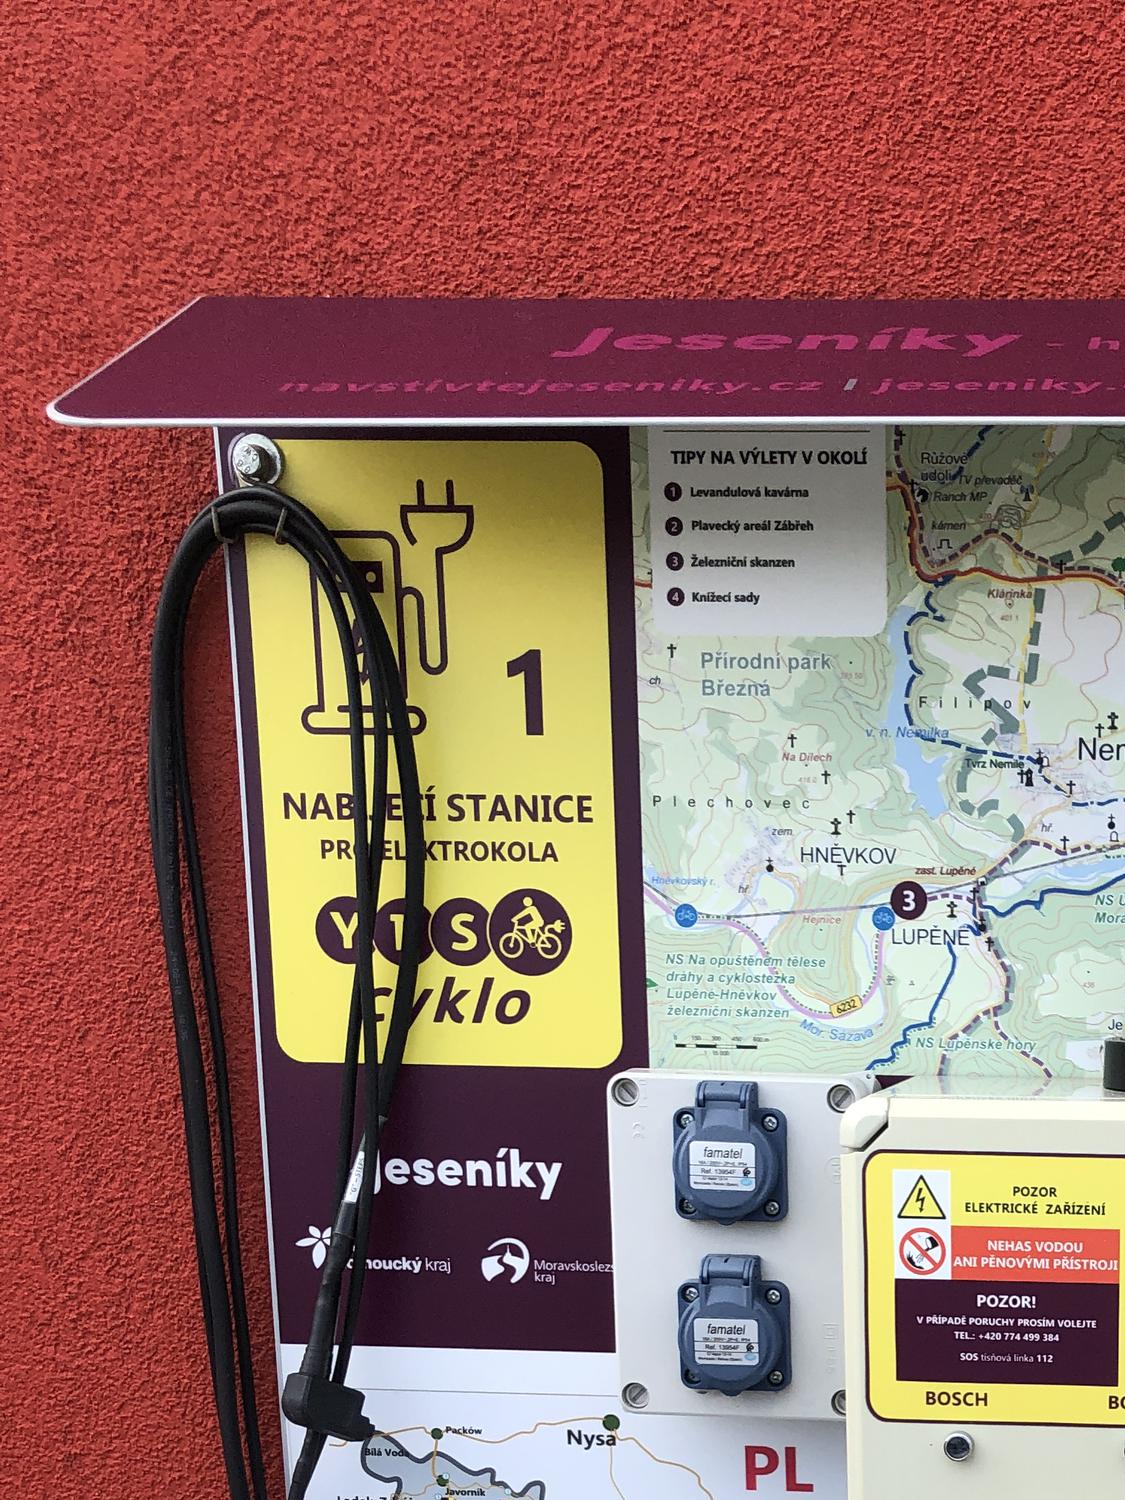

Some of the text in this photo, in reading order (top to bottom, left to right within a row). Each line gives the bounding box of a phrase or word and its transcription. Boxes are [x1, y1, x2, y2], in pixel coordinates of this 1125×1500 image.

[550, 327, 1023, 357] Jeseníky
[670, 447, 868, 465] TIPY NA VÝLETY V OKOLÍ
[690, 487, 761, 498] Levandulová
[765, 487, 809, 498] kavárna
[691, 521, 740, 533] Plavecký
[744, 521, 770, 531] areál
[774, 521, 813, 531] Zábřeh
[691, 555, 747, 567] Železniční
[750, 558, 795, 567] skanzen
[691, 592, 731, 602] Knížecí
[735, 593, 760, 605] sady
[701, 652, 831, 673] Přírodní park
[507, 649, 545, 736] 1
[701, 679, 771, 697] Březná
[447, 794, 593, 823] STANICE
[383, 840, 559, 862] ELKTROKOLA
[800, 843, 896, 864] HNĚVKOV
[902, 890, 915, 911] 3
[836, 998, 857, 1014] 6232
[703, 1146, 743, 1160] famatel
[1013, 1186, 1057, 1197] POZOR
[965, 1201, 1106, 1215] ELEKTRICKÉ ZAŘÍZENÍ
[987, 1240, 1083, 1253] NEHAS VODOU
[425, 1257, 451, 1274] kraj
[953, 1255, 1118, 1271] ANI PĚNOVÝMI PŘÍSTROJI
[534, 1271, 555, 1285] kraj
[976, 1295, 1036, 1308] POZOR!
[916, 1315, 1096, 1328] V PŘÍPADĚ PORUCHY PROSÍM VOLEJTE
[707, 1323, 746, 1336] famatel
[954, 1332, 1059, 1342] TEL.: +420 774 499 384
[960, 1352, 1053, 1362] SOS tísňová linka 112
[925, 1391, 988, 1406] BOSCH
[567, 1429, 616, 1448] Nysa
[744, 1445, 814, 1493] PL
